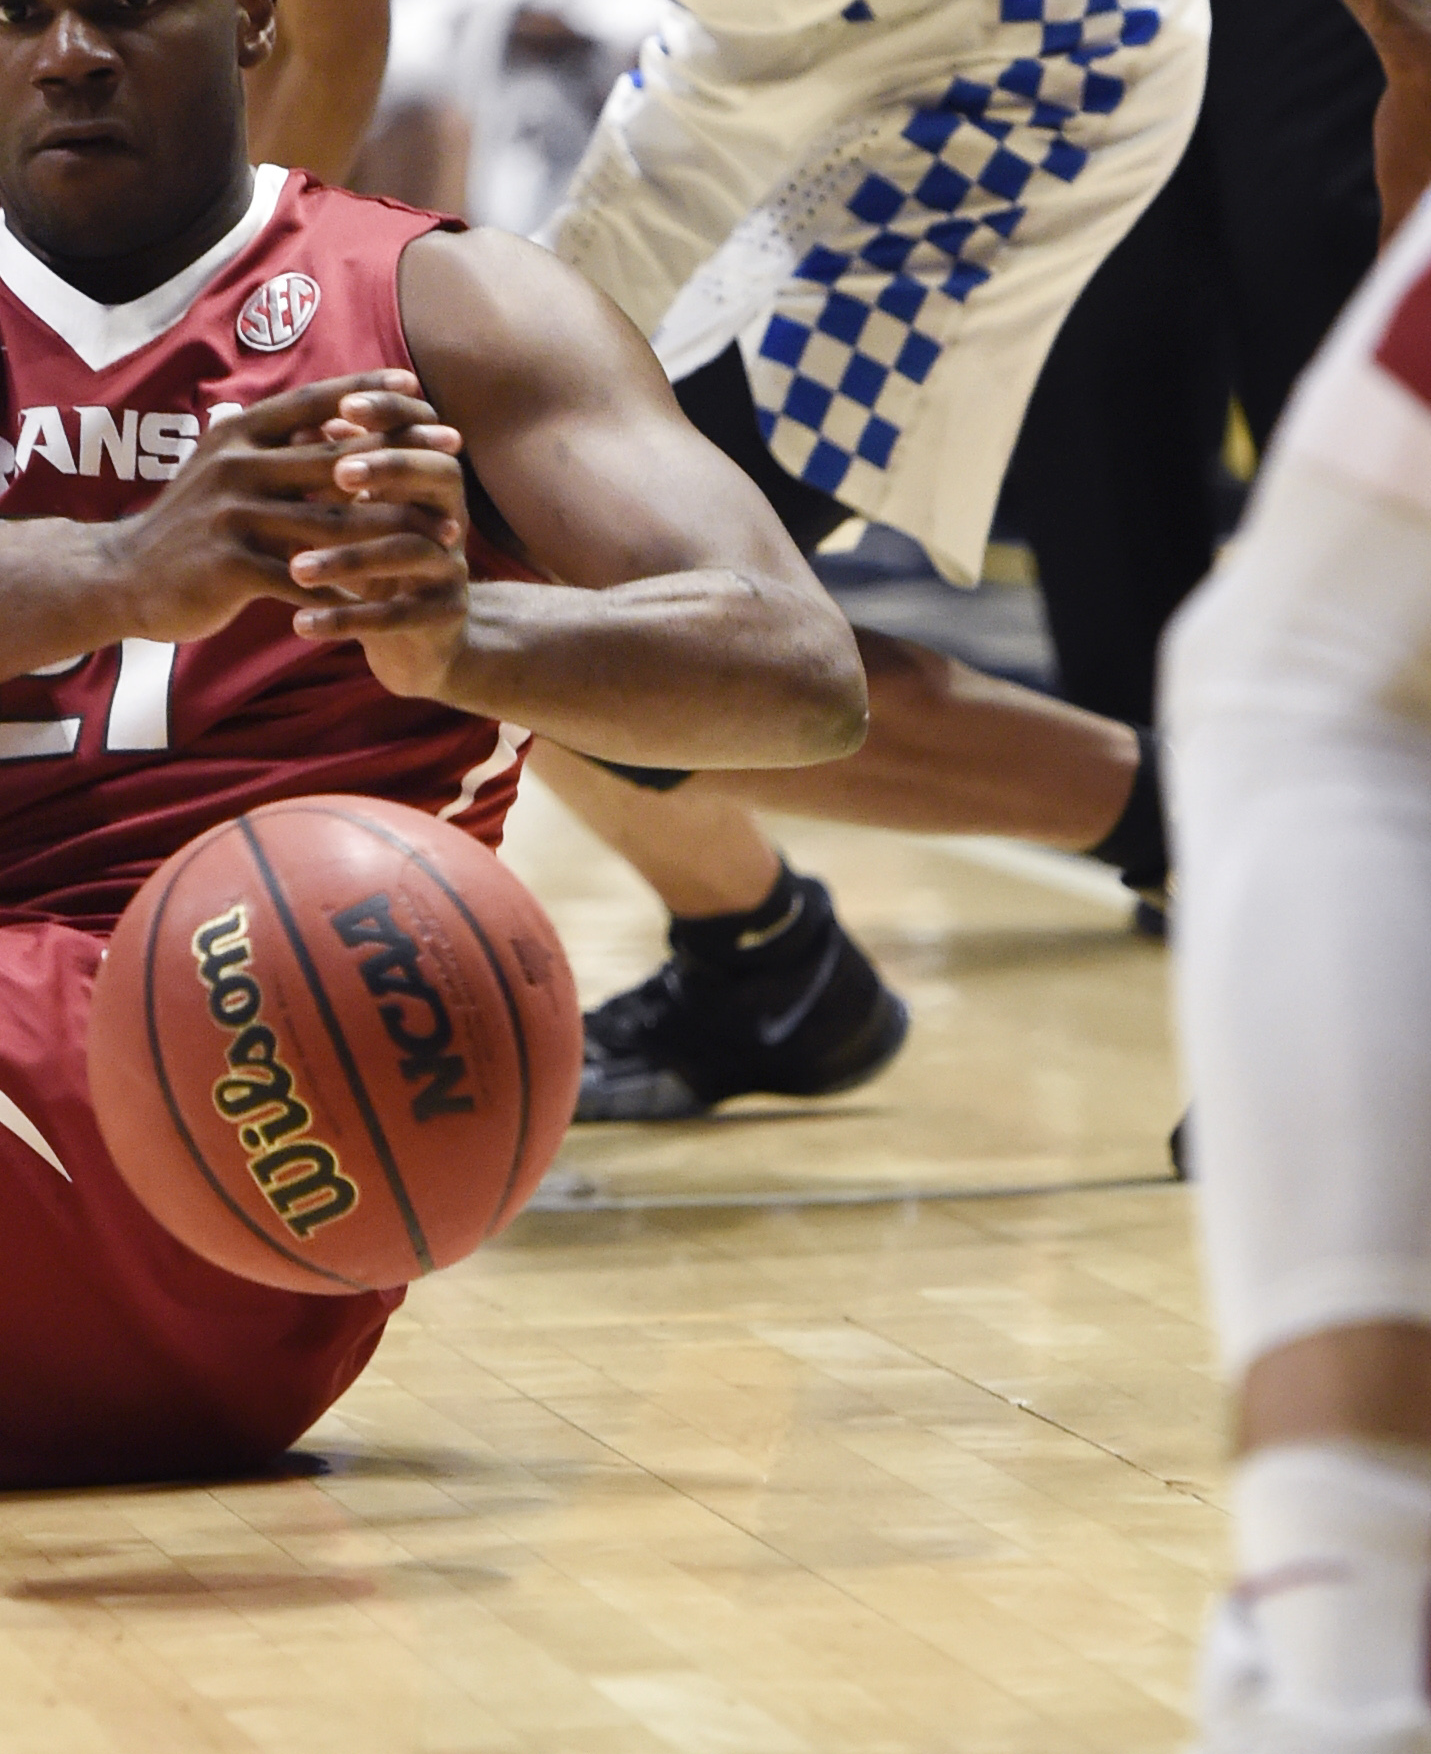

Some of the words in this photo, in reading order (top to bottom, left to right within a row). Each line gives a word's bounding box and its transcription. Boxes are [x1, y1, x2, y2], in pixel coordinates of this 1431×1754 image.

[239, 276, 316, 347] SEC
[192, 902, 358, 1242] Wilson
[330, 893, 475, 1123] NCAA
